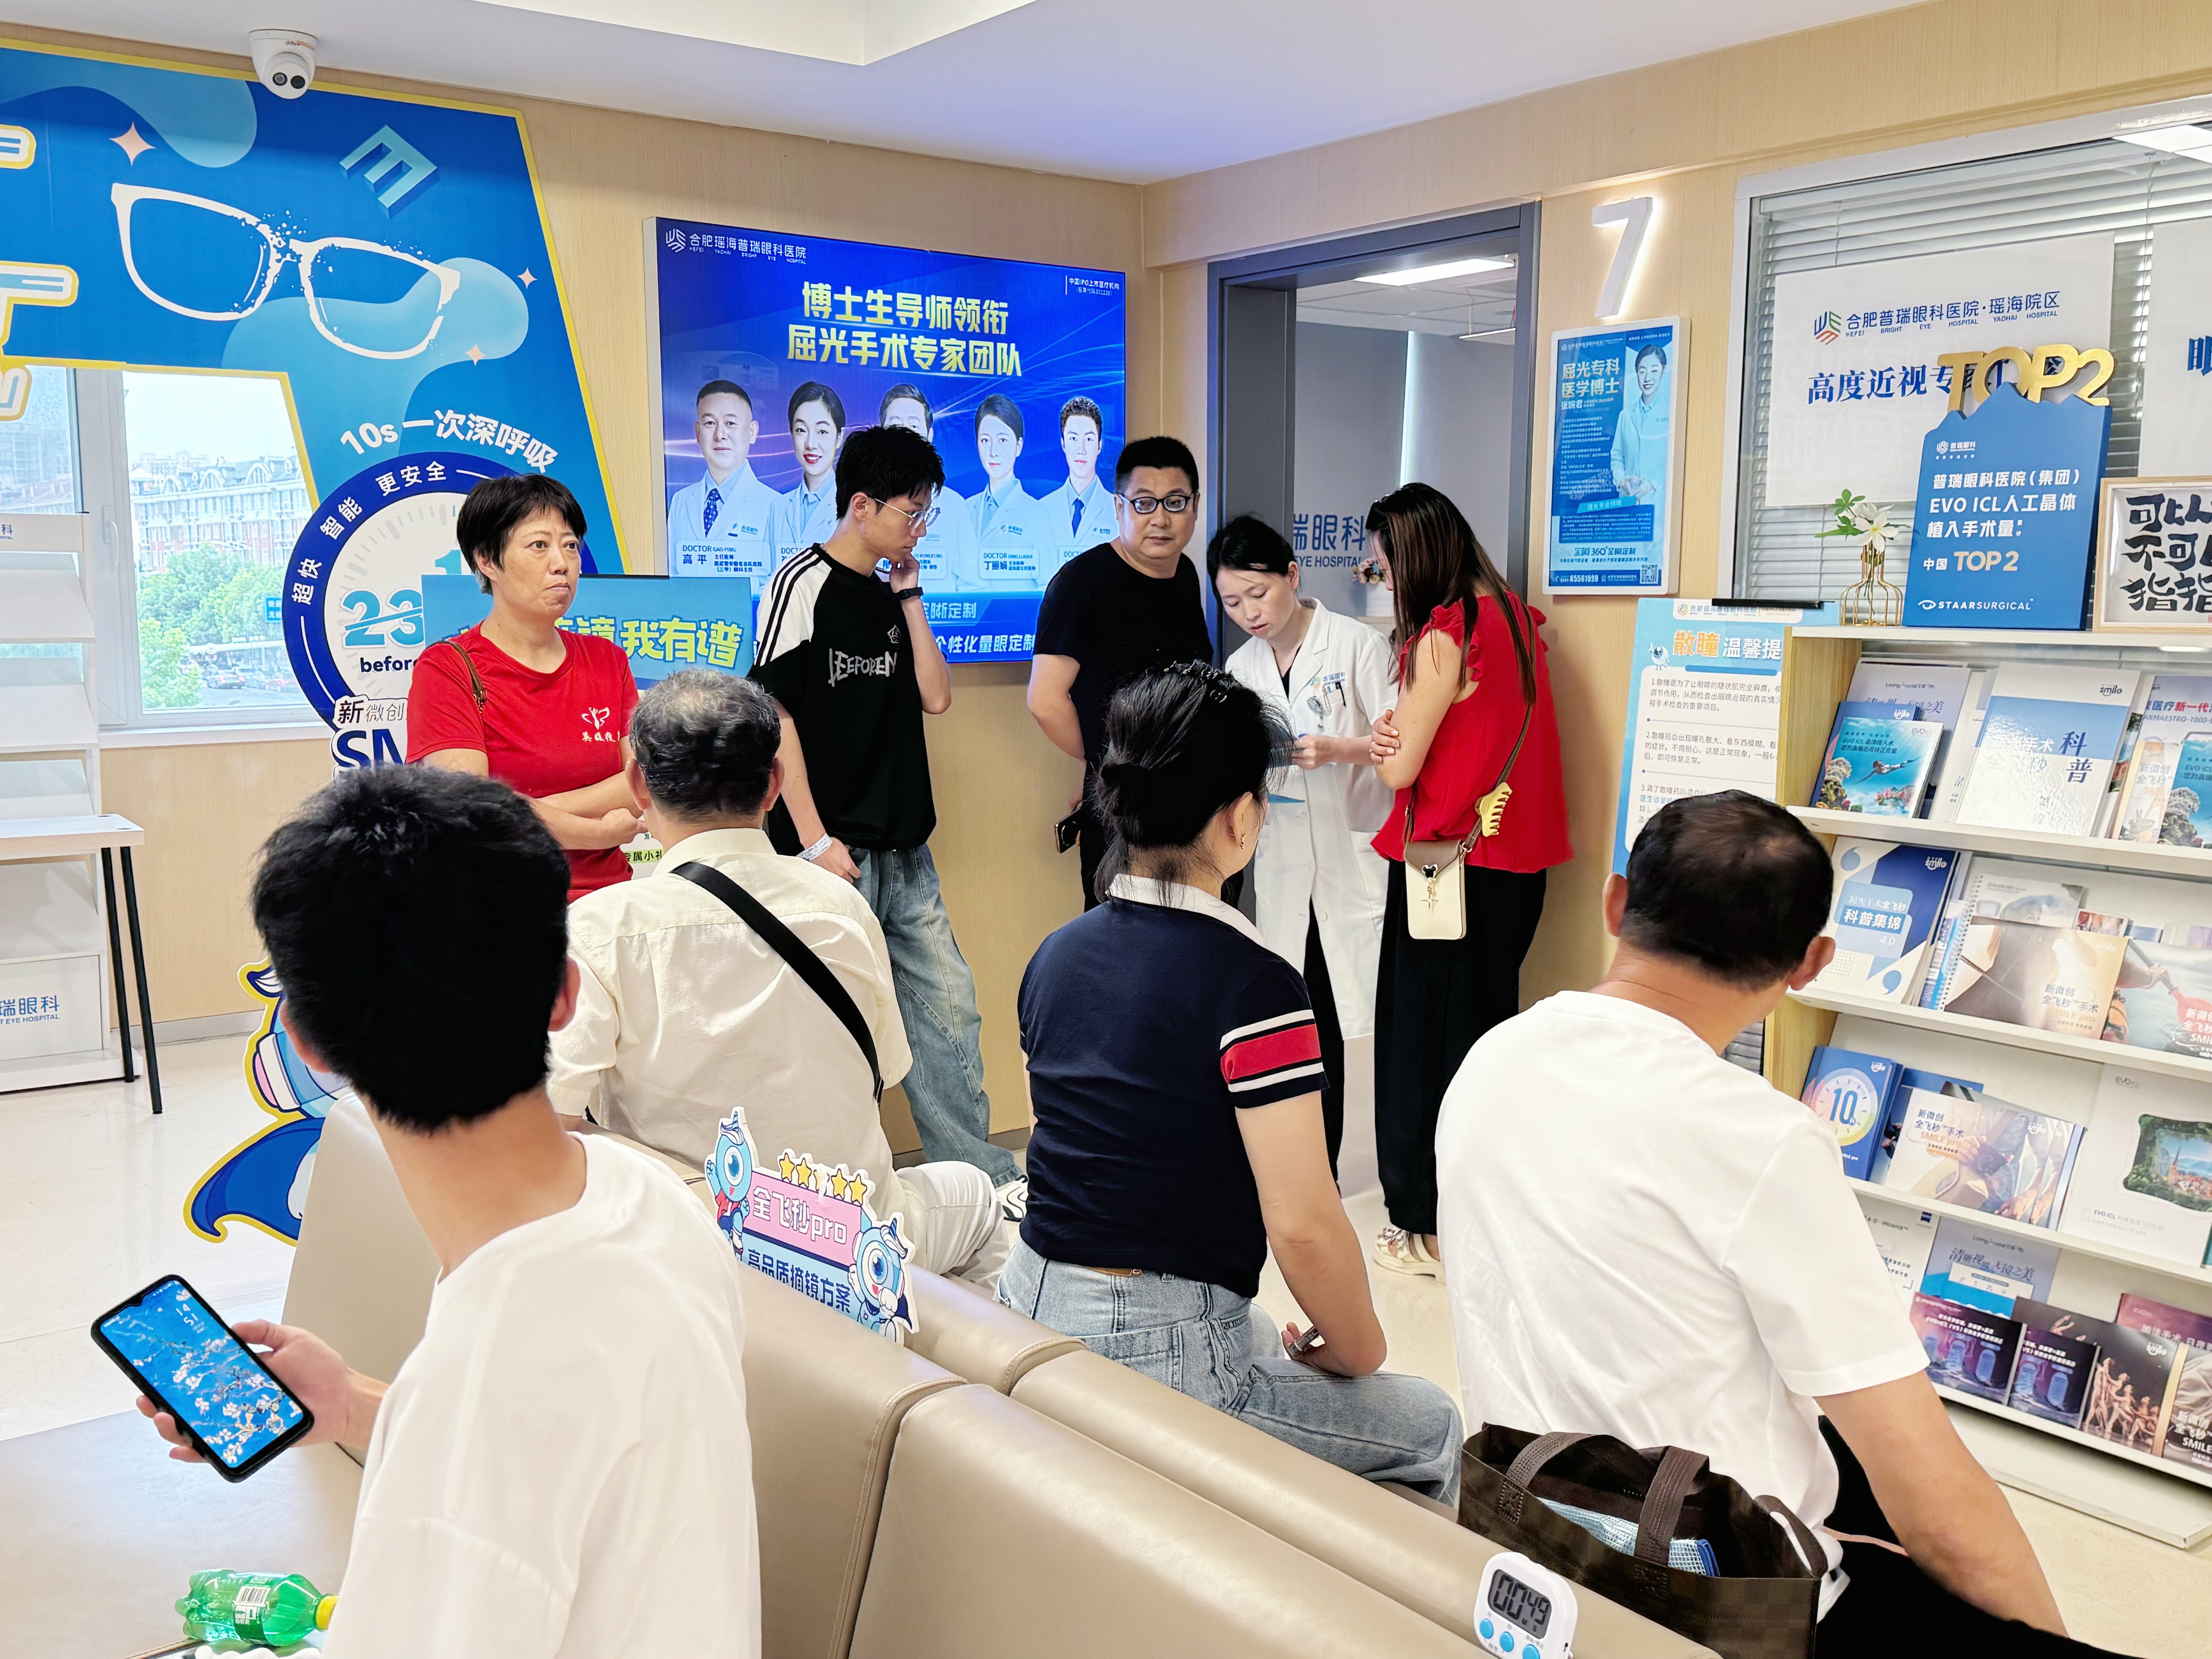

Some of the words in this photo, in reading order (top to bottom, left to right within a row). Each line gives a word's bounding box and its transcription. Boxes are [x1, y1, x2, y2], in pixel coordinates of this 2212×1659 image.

[689, 233, 807, 259] 合肥瑶海普瑞眼科医院
[1592, 196, 1653, 318] 7
[802, 280, 1009, 336] 博士生导师领衔
[1846, 290, 2061, 330] 合肥普瑞眼科医院·瑶海院区
[1881, 326, 1902, 334] BRIGHT
[1949, 318, 1978, 327] HOSPITAL
[2027, 310, 2058, 319] HOSPITAL
[788, 323, 1022, 377] 屈光手术专家团队
[1562, 357, 1620, 380] 屈光专科
[1937, 344, 2115, 413] TOP2
[1562, 377, 1620, 398] 医学博士
[1933, 469, 2080, 489] 普瑞眼科医院（集团）
[1930, 497, 1966, 513] EVO
[1, 524, 13, 535] 科
[291, 558, 322, 605] 超快
[320, 496, 362, 541] 智能
[375, 460, 447, 497] 更安全
[682, 544, 712, 553] DOCTOR
[1923, 558, 1948, 571] 中国
[1673, 630, 1720, 658] 散瞳
[1723, 637, 1782, 660] 温馨提
[338, 700, 404, 724] 新微创
[1844, 908, 1902, 931] 科普集锦
[1880, 936, 1896, 946] 4.0
[22, 1013, 60, 1022] HOSPITAL
[1917, 1109, 1944, 1123] 新微创
[753, 1185, 847, 1245] 全飞秒pro
